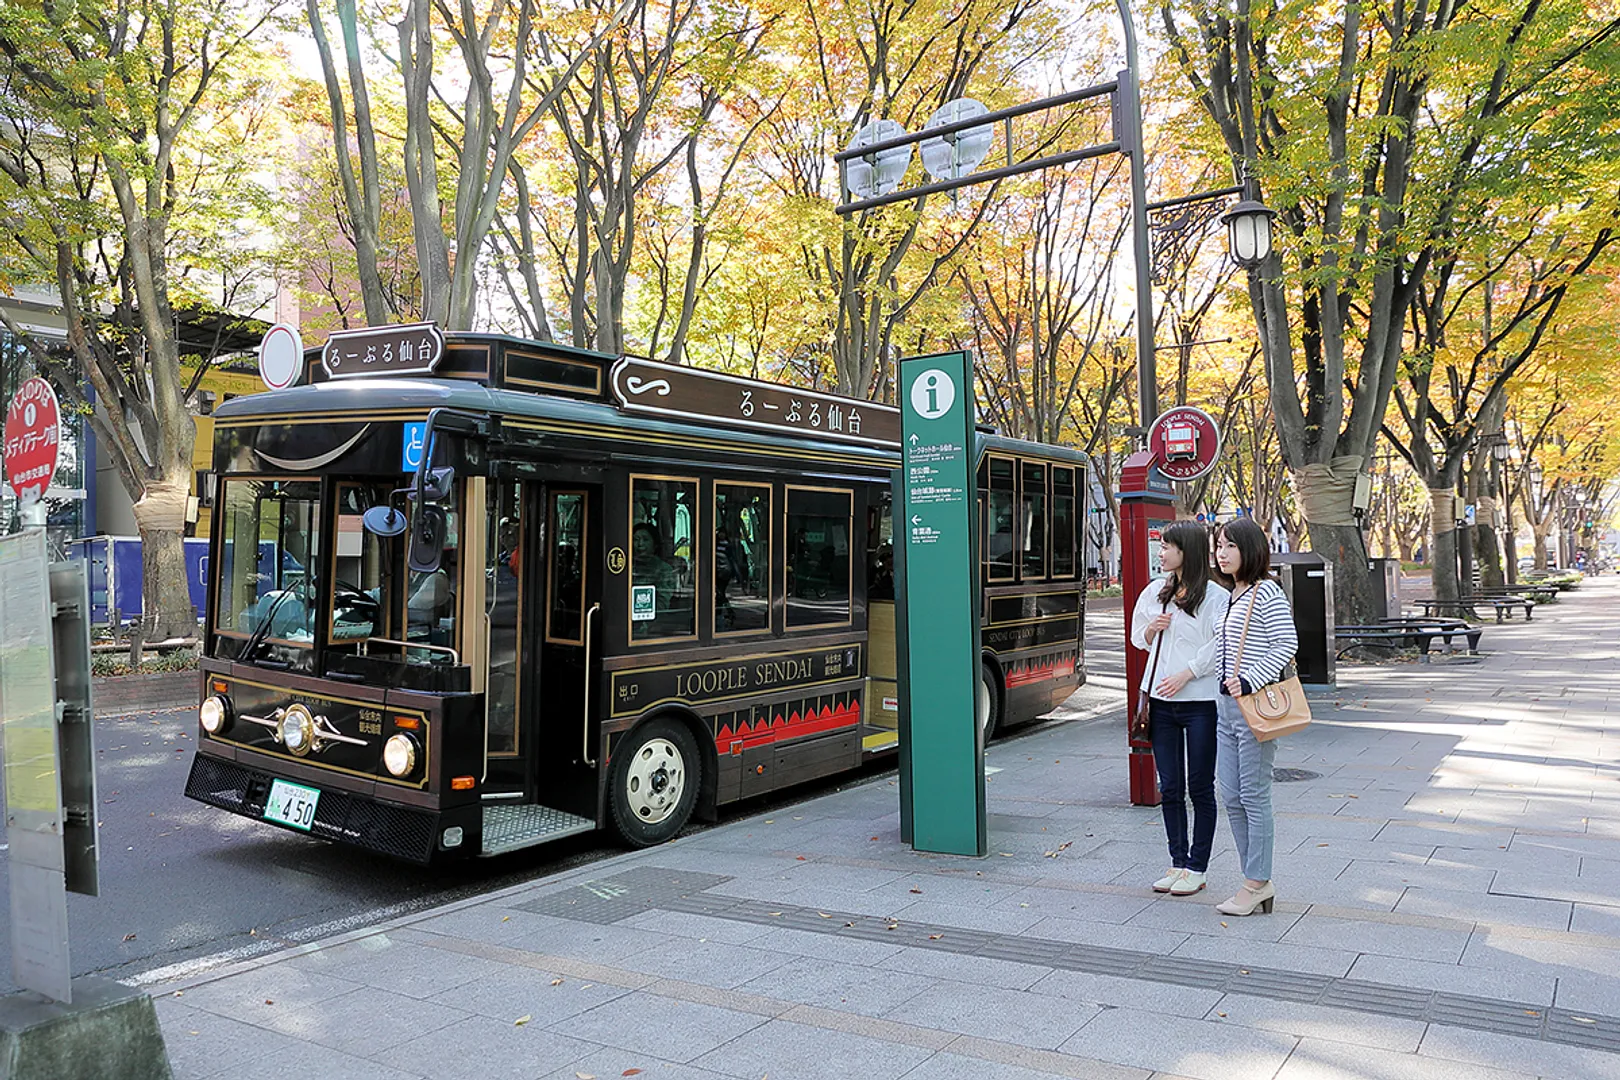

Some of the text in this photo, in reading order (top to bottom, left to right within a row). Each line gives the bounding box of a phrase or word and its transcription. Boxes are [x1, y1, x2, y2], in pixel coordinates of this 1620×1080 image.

[330, 337, 432, 367] るーぷる仙台
[740, 390, 861, 434] るーぷる仙台
[1161, 413, 1206, 428] LOOPLE SENDAI
[1162, 461, 1206, 476] るーぷる仙台
[619, 684, 639, 698] 出口
[675, 657, 812, 698] LOOPLE SENDAI
[282, 797, 313, 826] 450
